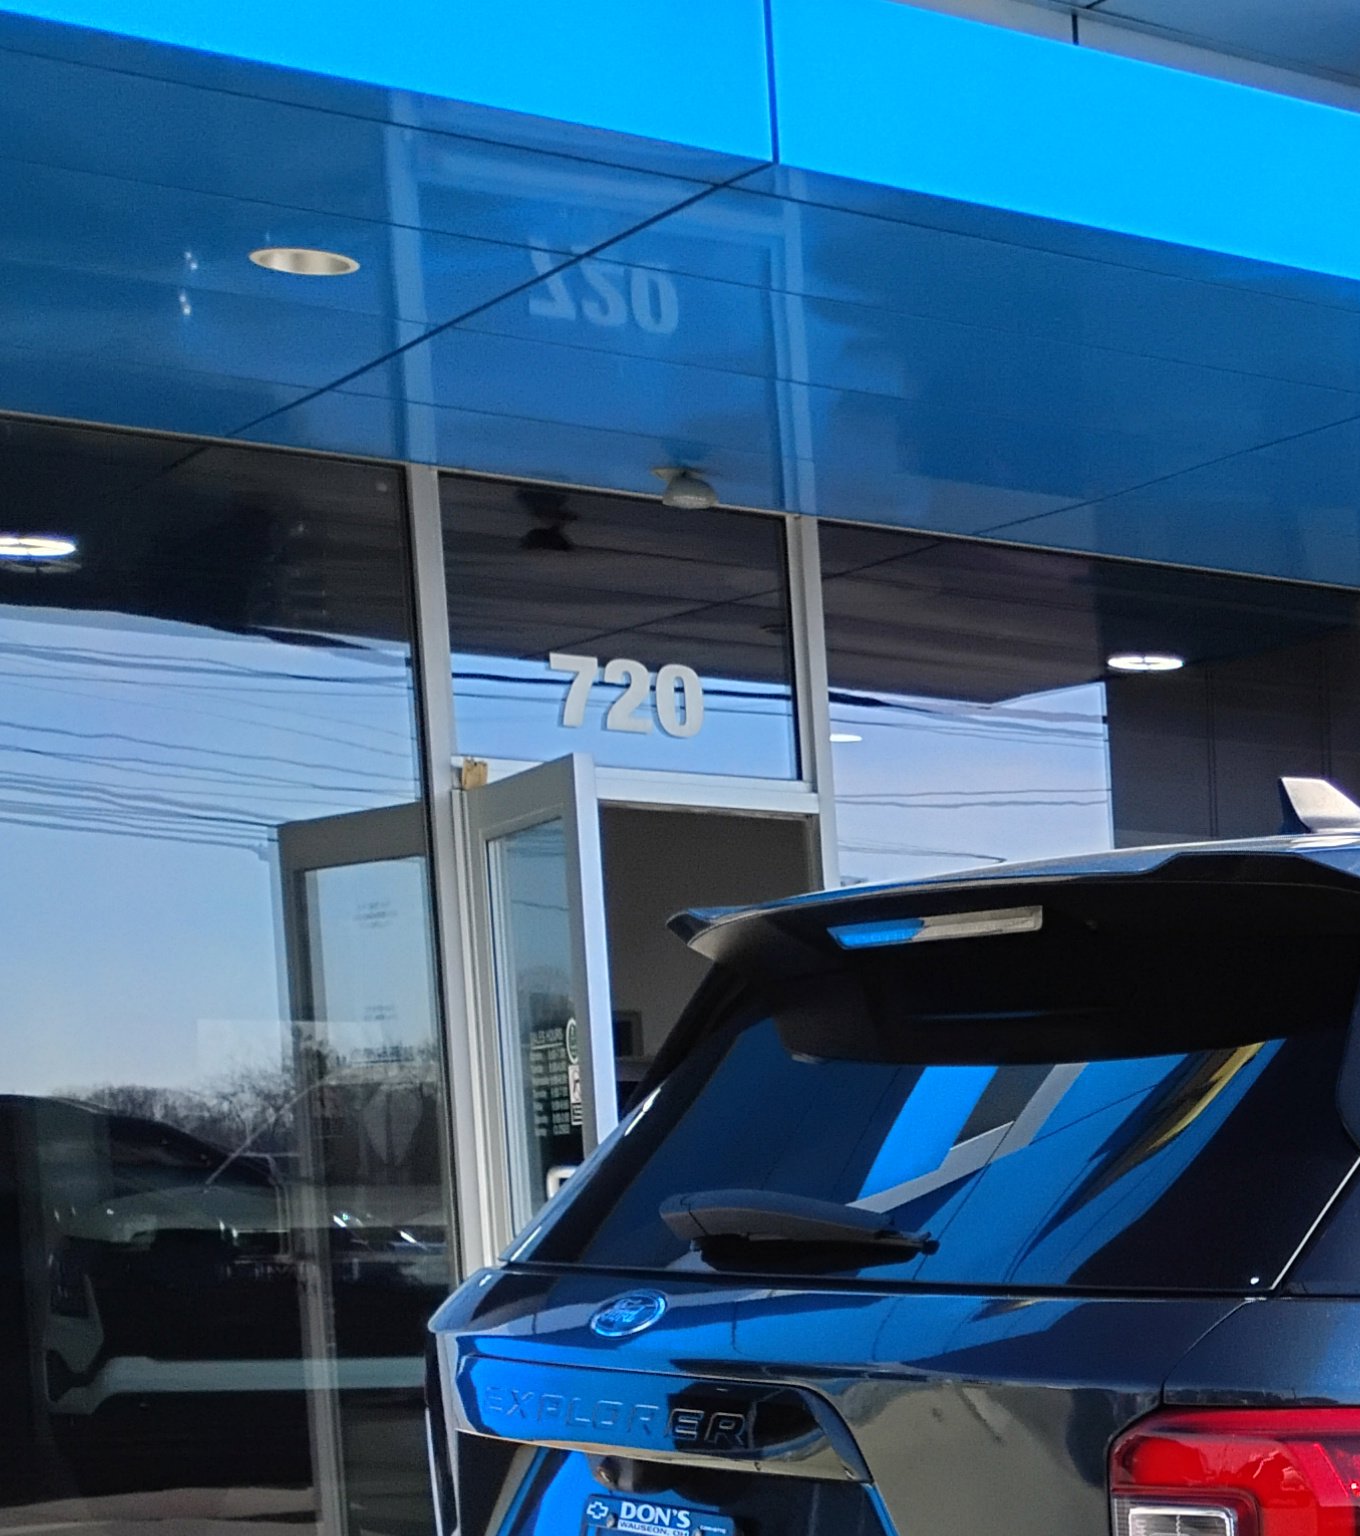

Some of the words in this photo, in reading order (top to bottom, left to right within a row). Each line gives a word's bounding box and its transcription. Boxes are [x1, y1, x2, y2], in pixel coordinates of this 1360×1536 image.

[549, 652, 704, 739] 720
[486, 1386, 748, 1447] EXPLORER
[620, 1501, 691, 1528] DON'S
